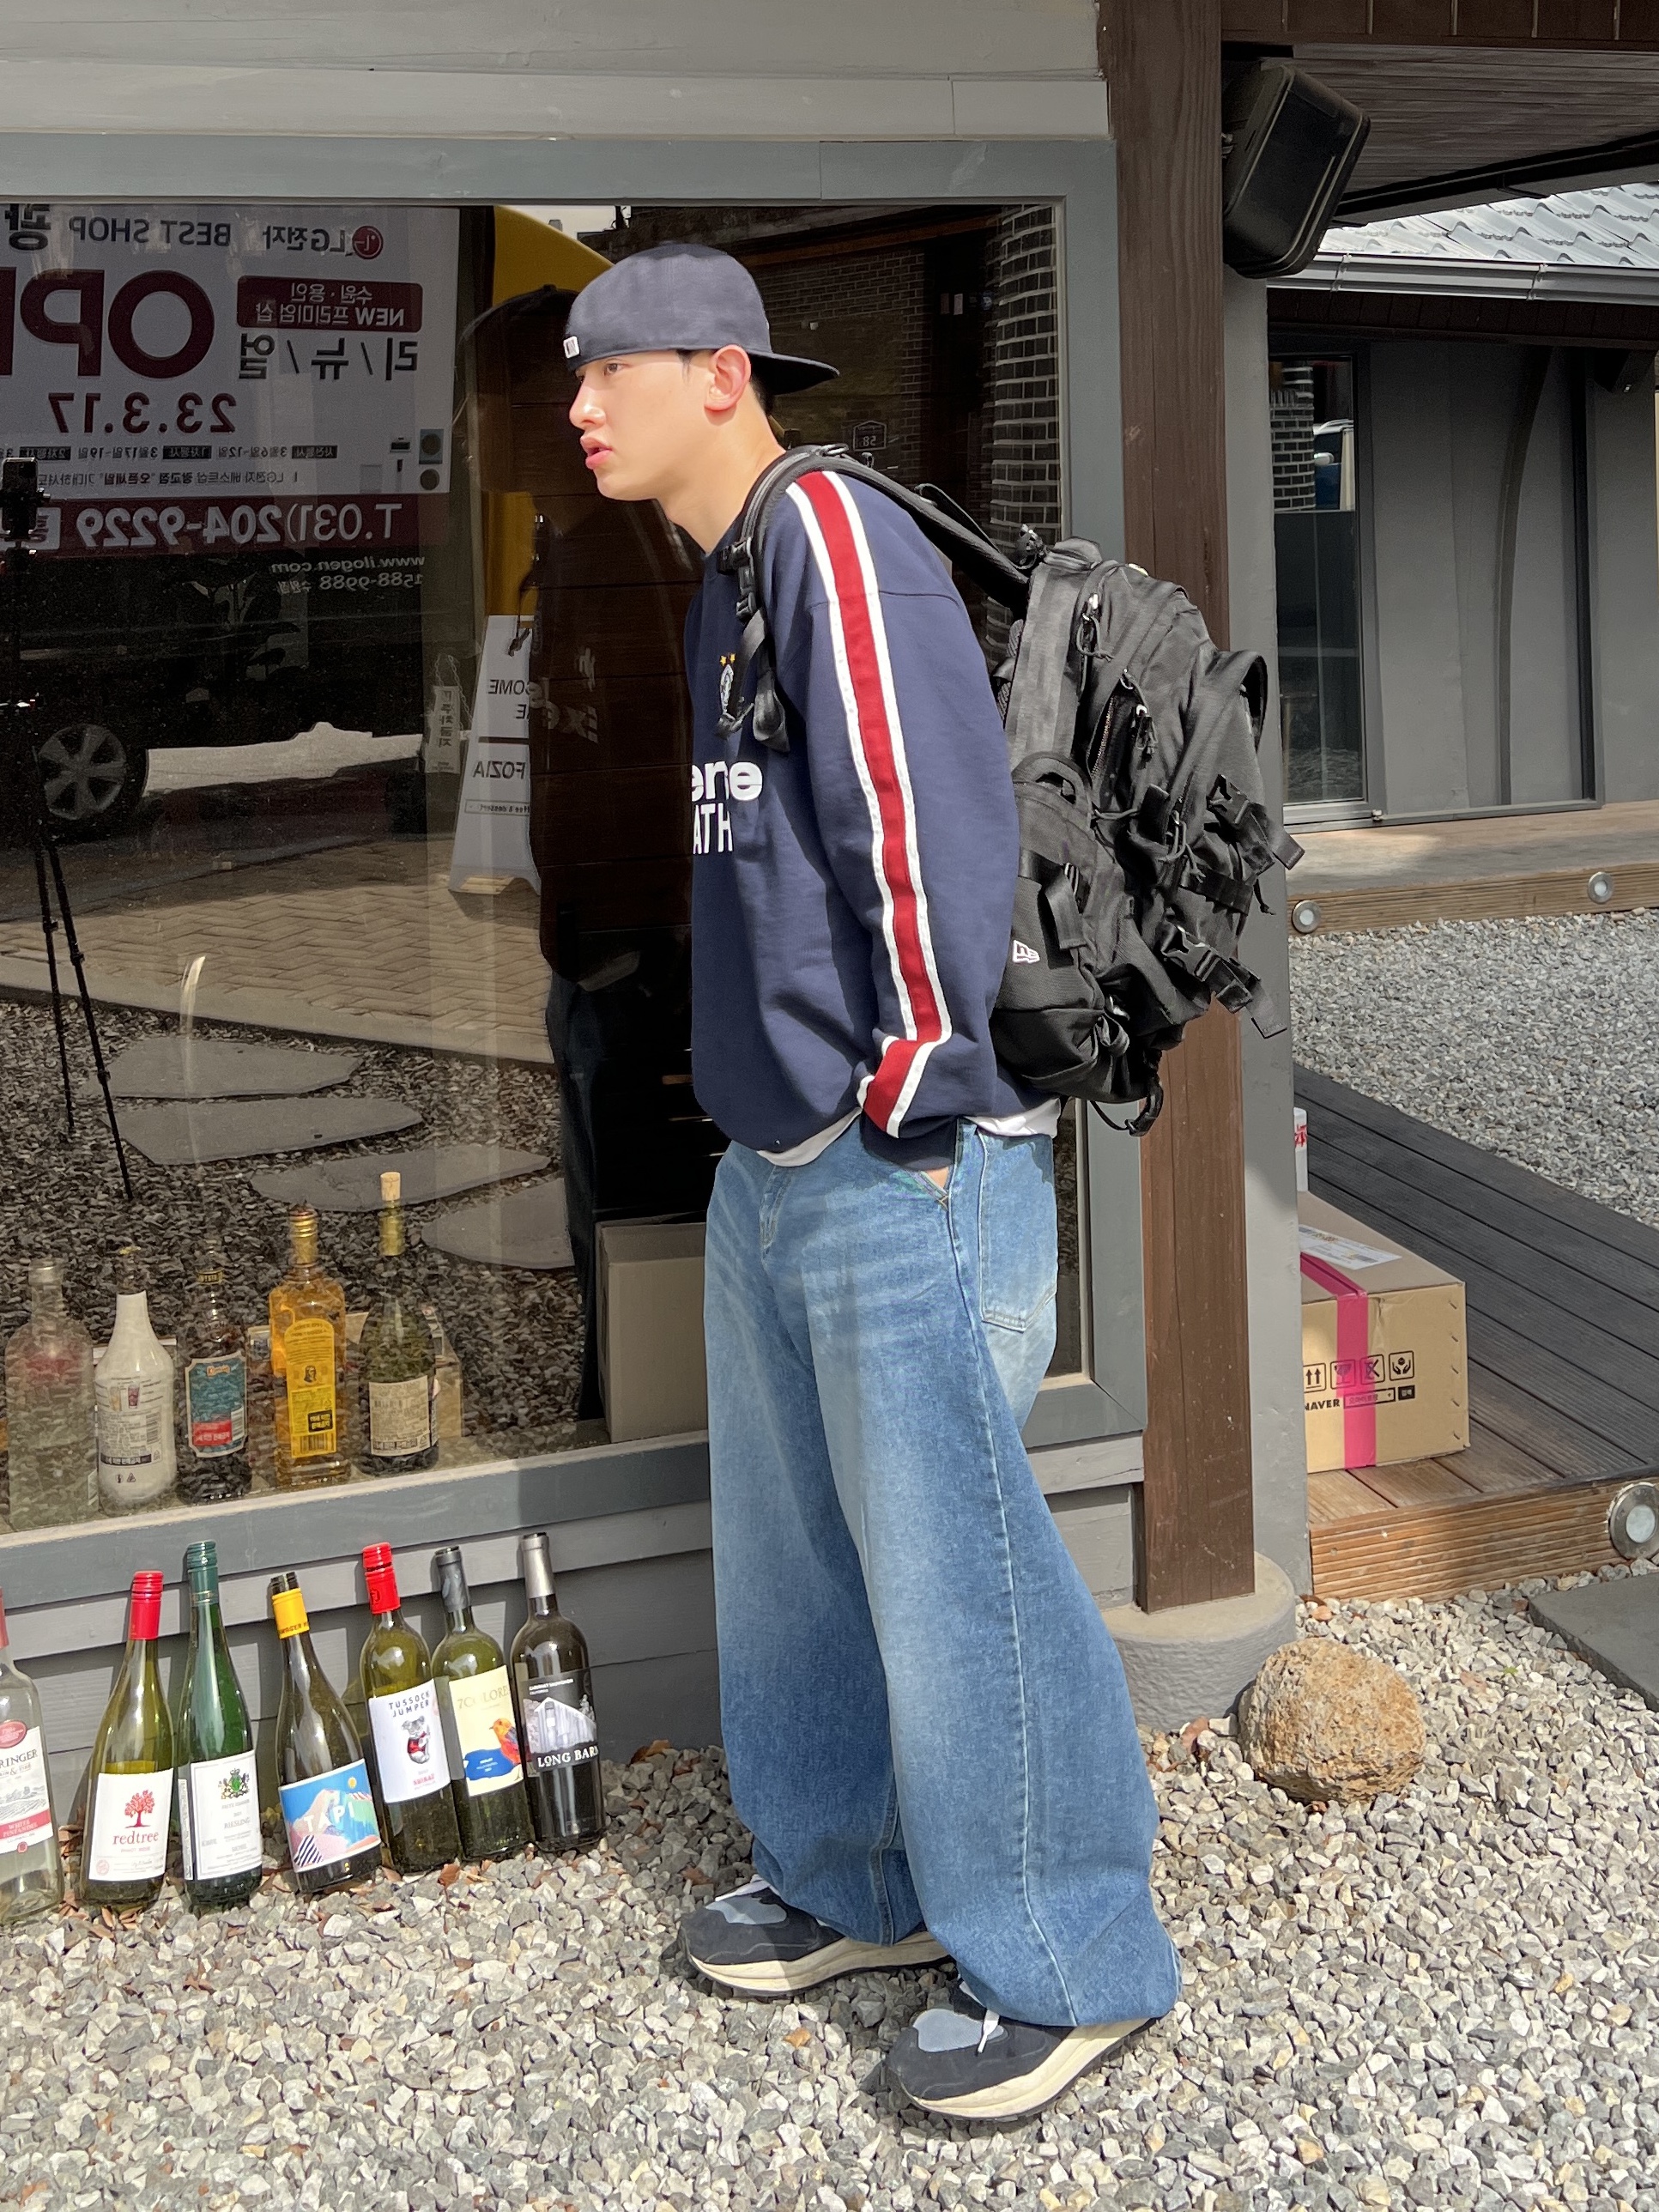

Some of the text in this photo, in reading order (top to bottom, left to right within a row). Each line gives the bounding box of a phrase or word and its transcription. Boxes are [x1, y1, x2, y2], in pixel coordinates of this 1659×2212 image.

[389, 1691, 430, 1711] TUSSOCK
[392, 1700, 430, 1718] JUMPER
[537, 1752, 572, 1768] LONG
[303, 1800, 355, 1833] TAPI
[112, 1830, 160, 1845] redtree
